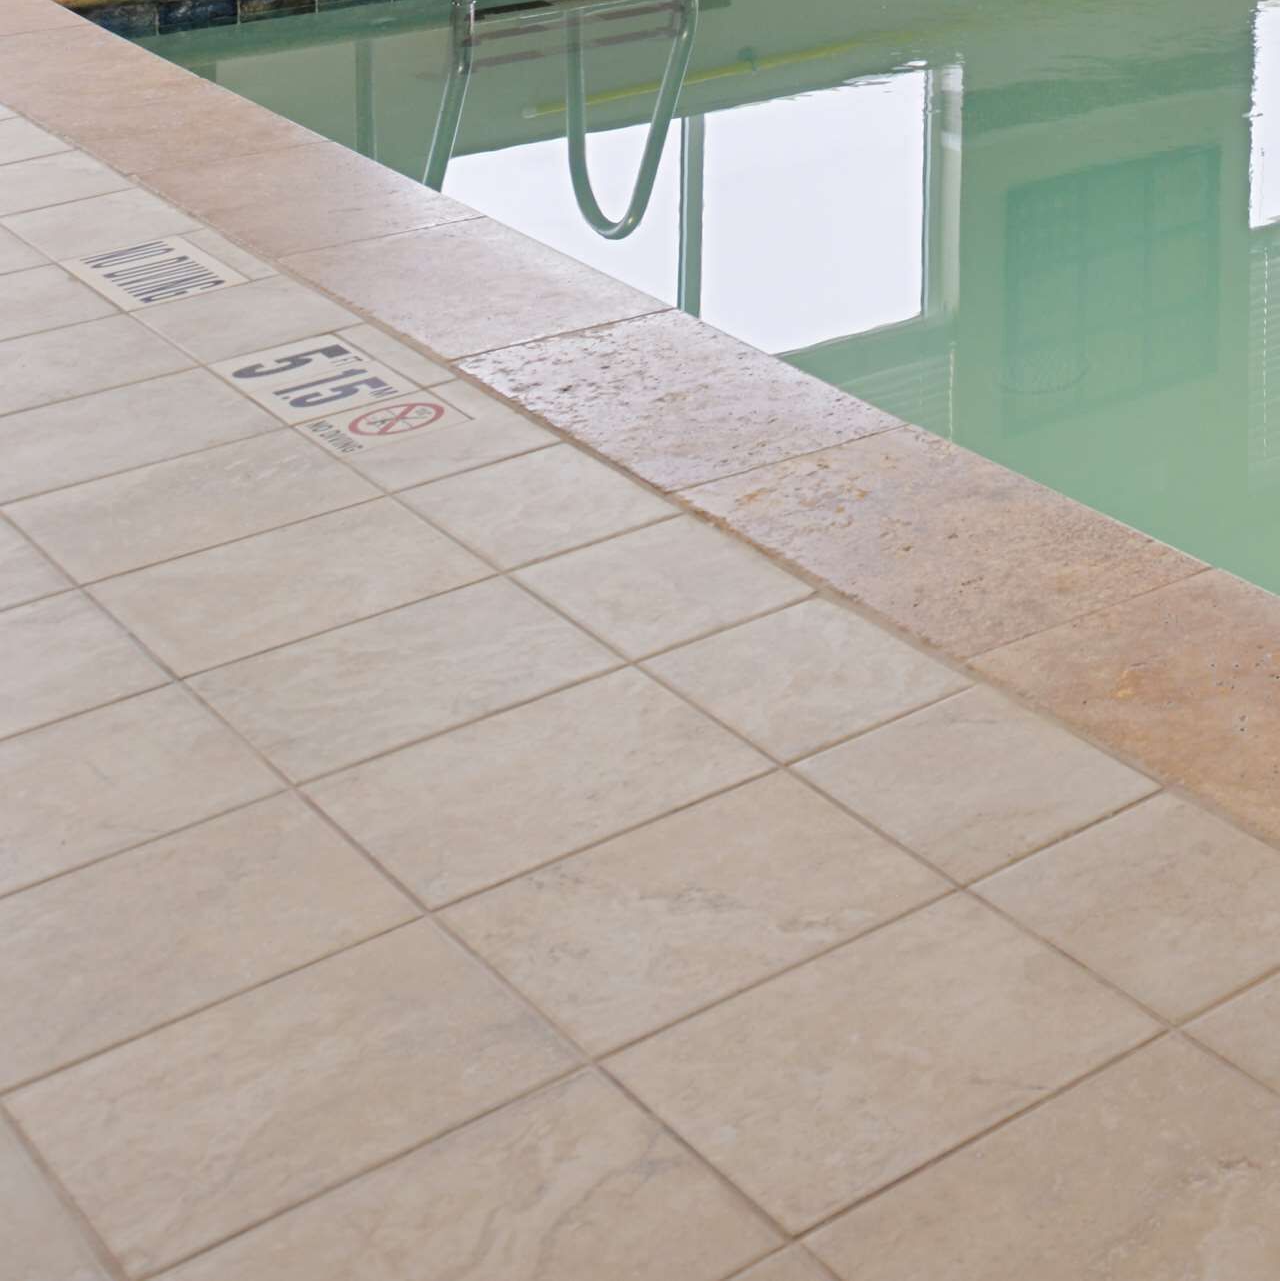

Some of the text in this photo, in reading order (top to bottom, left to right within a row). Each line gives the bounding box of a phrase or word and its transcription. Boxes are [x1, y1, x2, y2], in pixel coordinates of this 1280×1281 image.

[80, 241, 226, 303] NO DIVING
[232, 344, 351, 379] 5
[306, 420, 364, 454] NO DIVING
